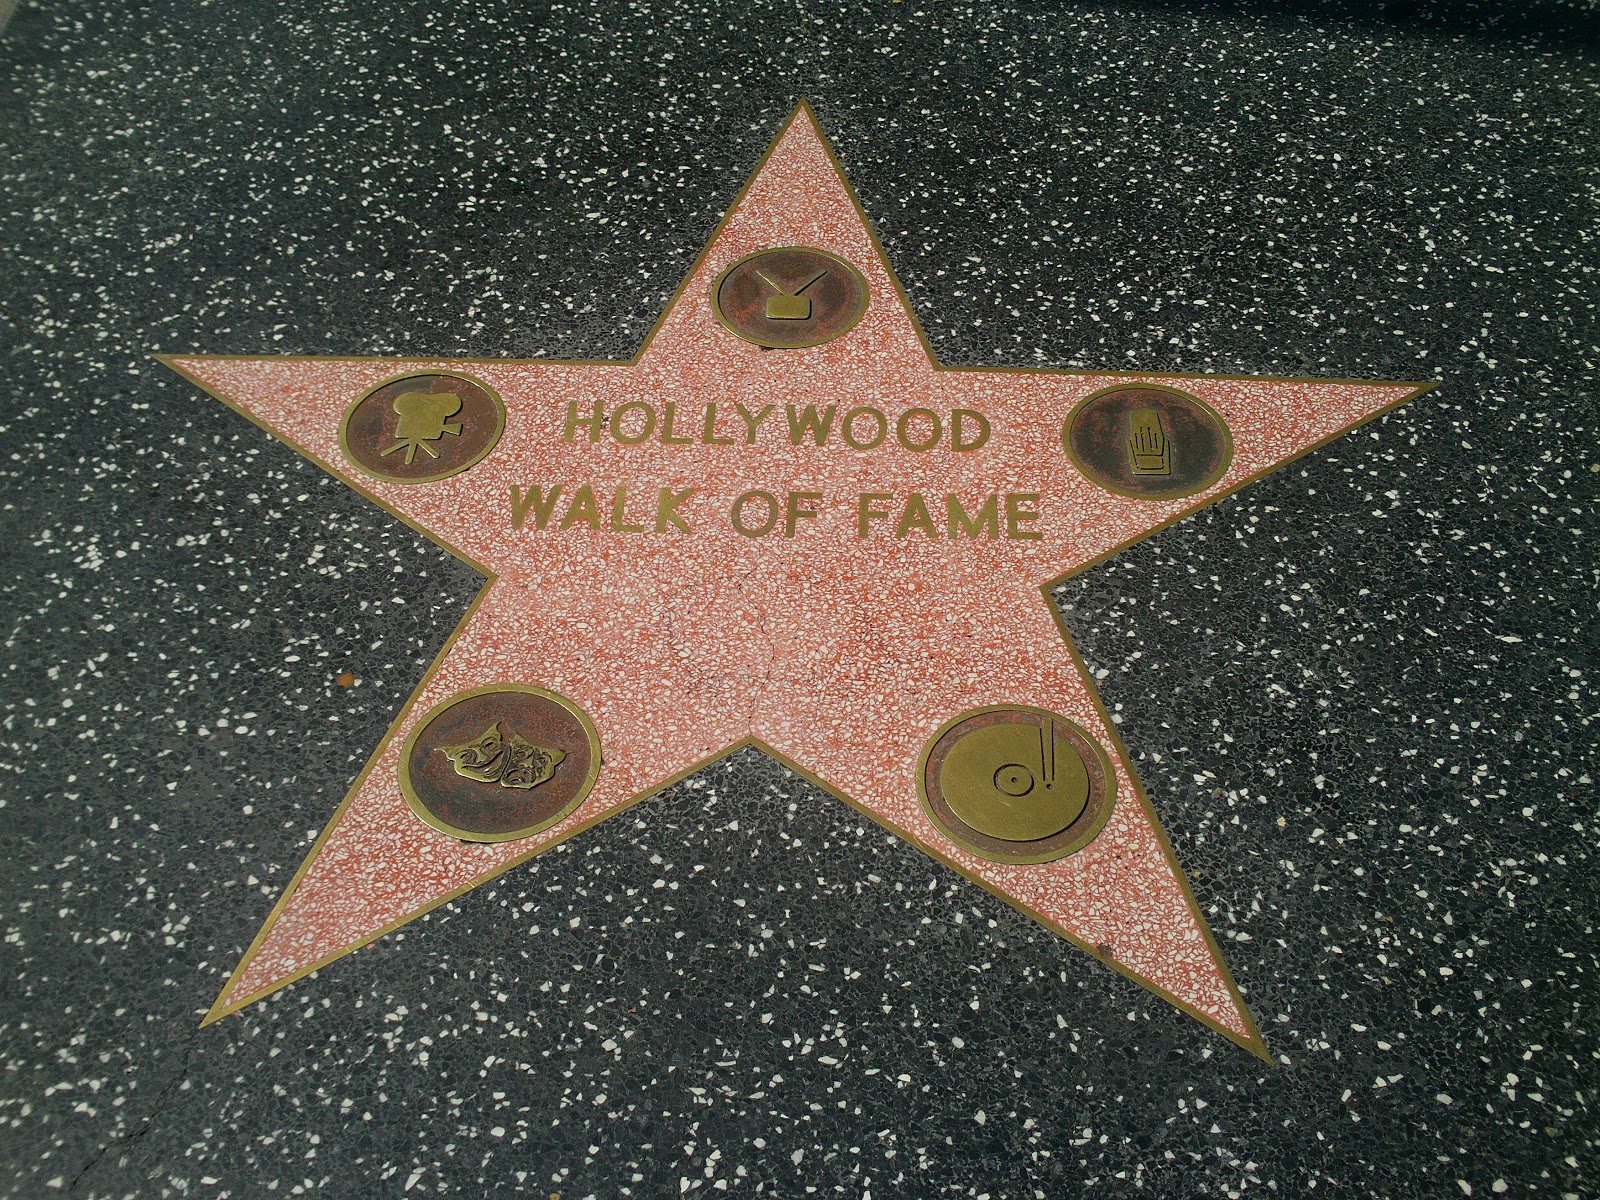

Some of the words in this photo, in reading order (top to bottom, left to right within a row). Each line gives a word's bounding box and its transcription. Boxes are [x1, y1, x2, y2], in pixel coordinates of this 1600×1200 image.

[563, 399, 992, 453] HOLLYWOOD
[509, 484, 697, 534] WALK
[730, 490, 820, 538] OF
[857, 492, 1044, 540] FAME
